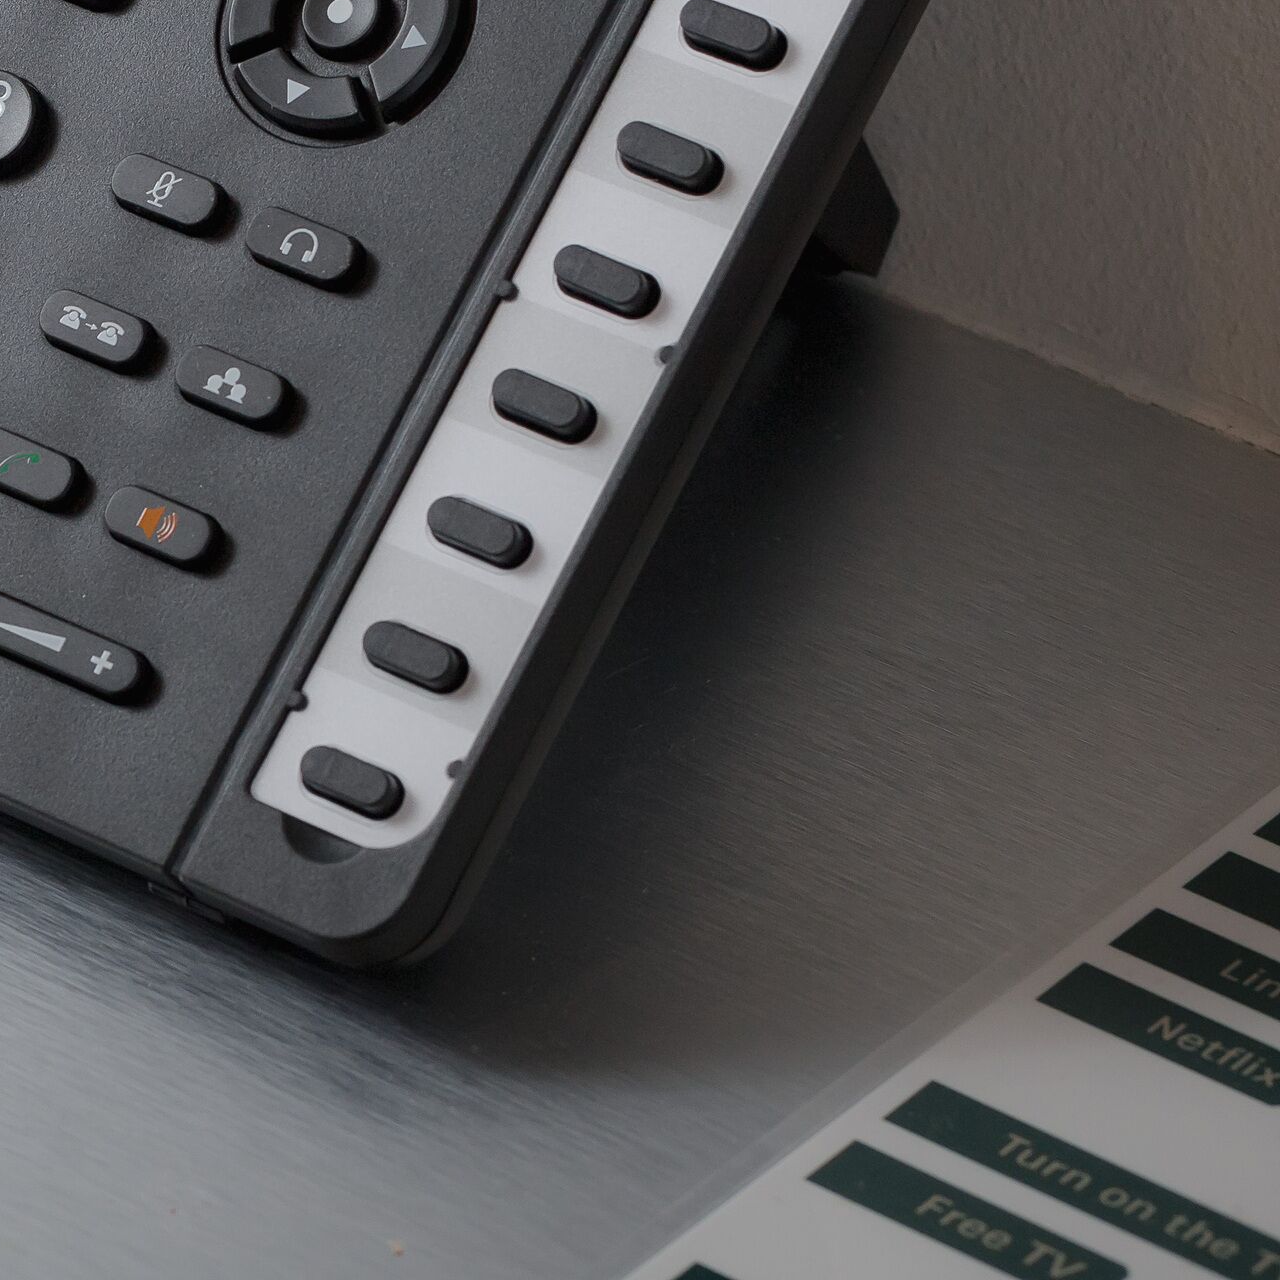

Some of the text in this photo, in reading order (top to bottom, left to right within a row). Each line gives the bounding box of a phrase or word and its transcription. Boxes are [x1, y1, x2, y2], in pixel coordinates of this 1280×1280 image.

[1146, 1014, 1280, 1089] Netflix
[914, 1192, 1091, 1280] Free TV
[997, 1132, 1093, 1194] Turn
[1098, 1186, 1156, 1223] on
[1164, 1217, 1239, 1264] the
